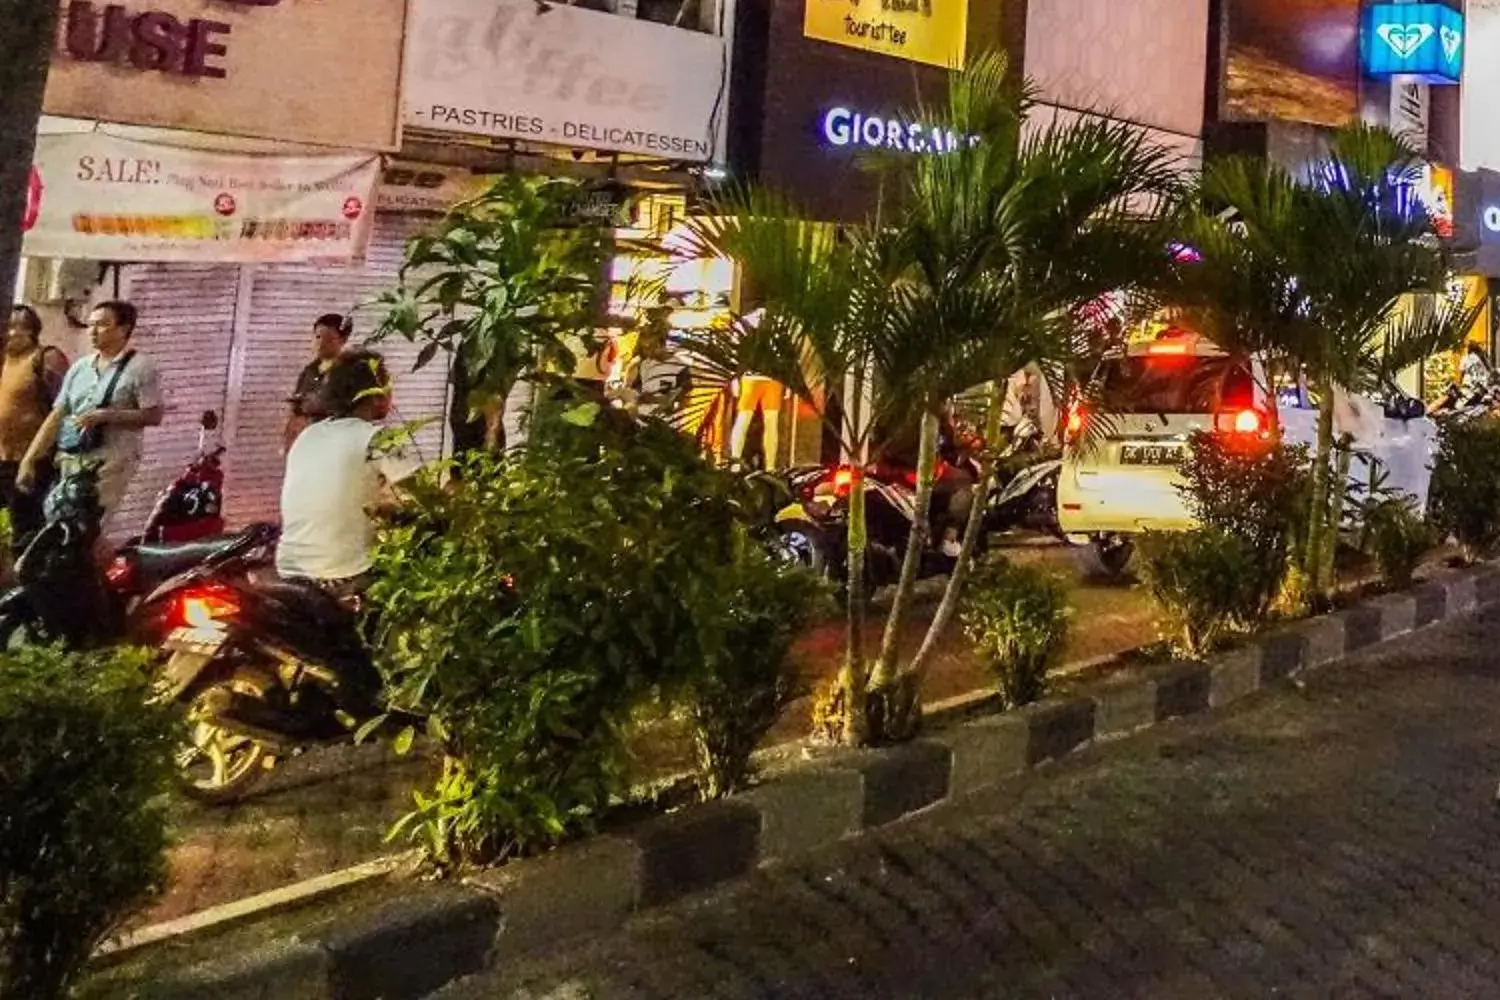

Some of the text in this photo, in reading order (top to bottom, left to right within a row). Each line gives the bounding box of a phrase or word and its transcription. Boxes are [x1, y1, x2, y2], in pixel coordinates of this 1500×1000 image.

[431, 104, 544, 135] PASTRIES
[562, 121, 709, 155] DELICATESSEN
[77, 155, 163, 187] SALE!
